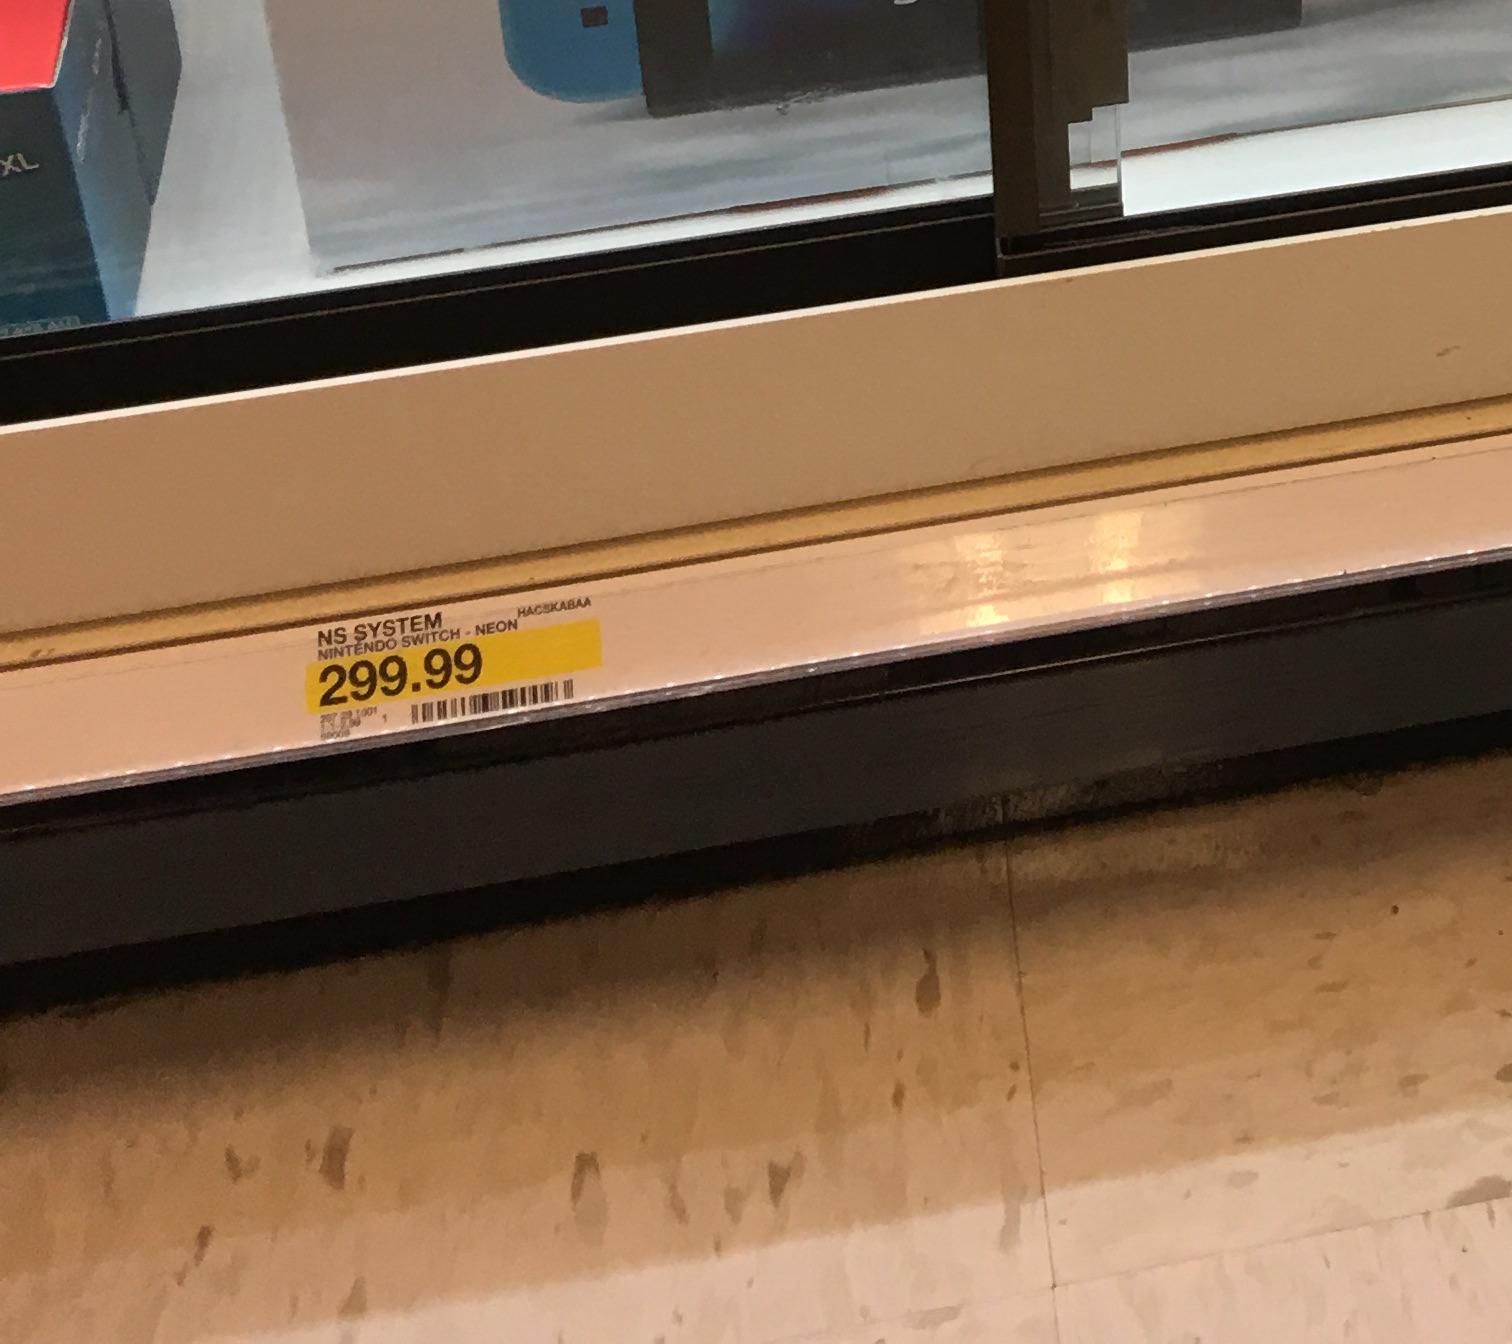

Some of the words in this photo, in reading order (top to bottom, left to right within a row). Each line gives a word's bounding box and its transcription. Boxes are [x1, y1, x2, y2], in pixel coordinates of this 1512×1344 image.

[317, 627, 347, 647] NS
[354, 612, 442, 641] SYSTEM
[318, 638, 397, 661] NINTENDO
[402, 628, 460, 648] SWITCH
[475, 618, 518, 636] NEON
[319, 643, 483, 707] 299.99
